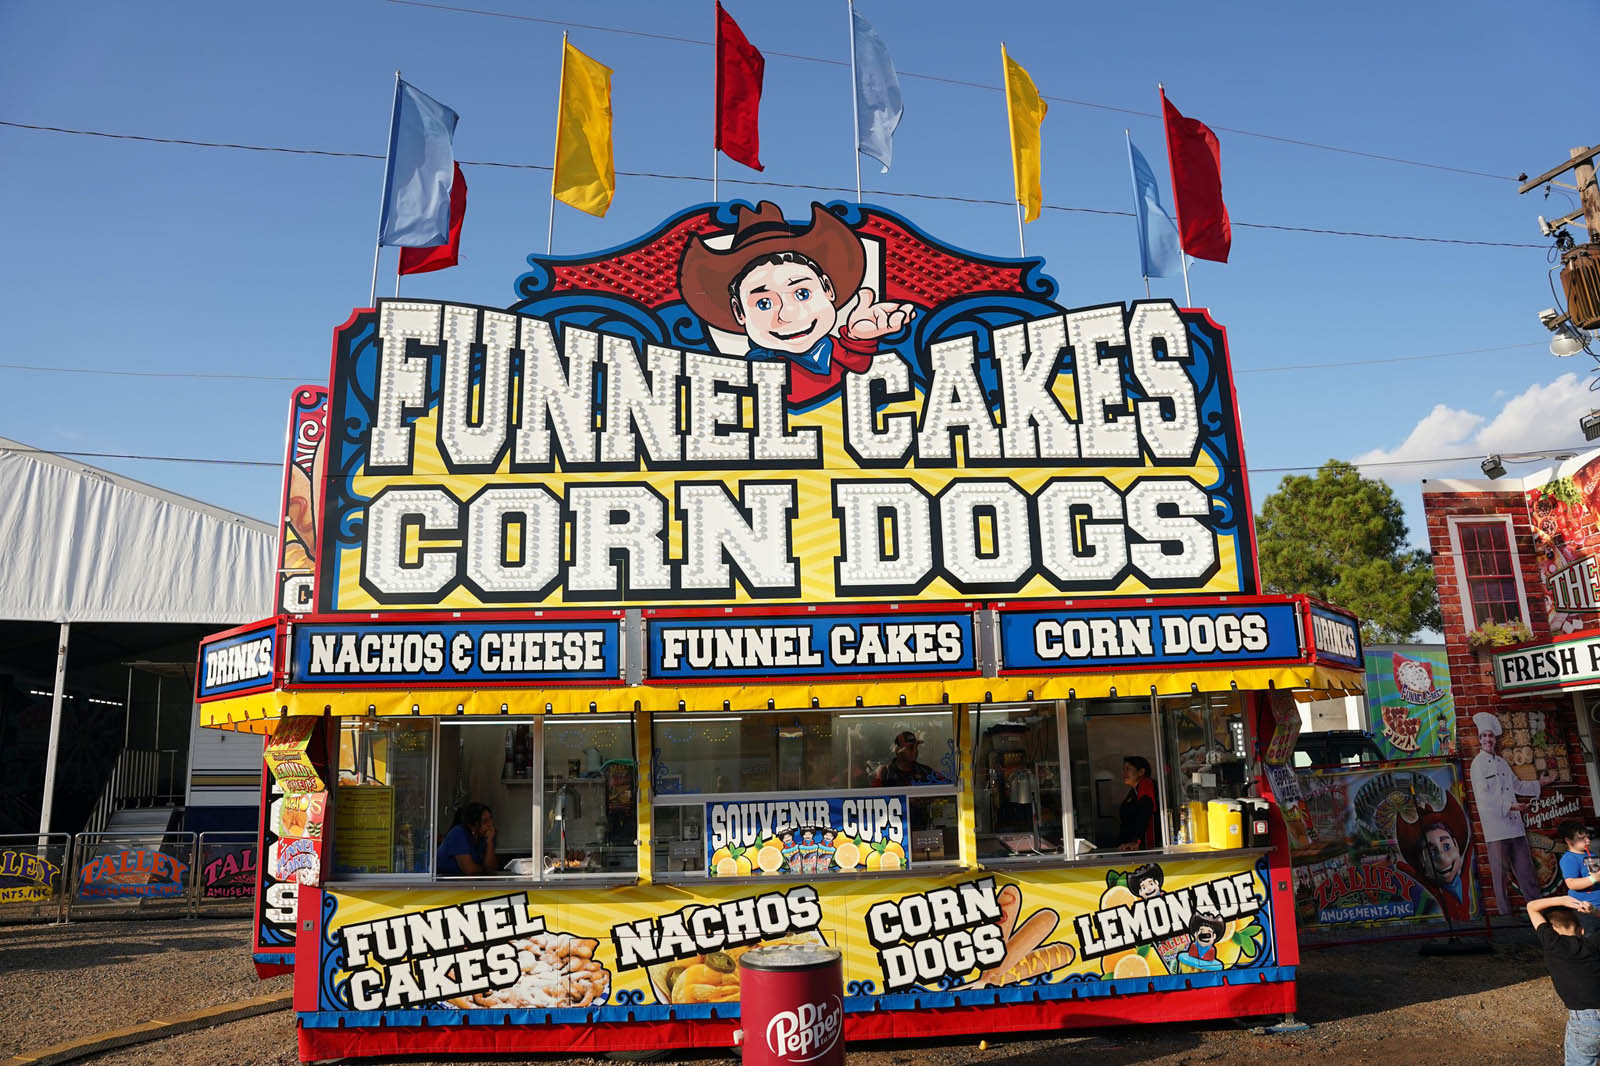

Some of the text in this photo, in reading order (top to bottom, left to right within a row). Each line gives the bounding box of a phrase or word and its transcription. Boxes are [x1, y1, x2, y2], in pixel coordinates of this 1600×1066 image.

[369, 300, 1200, 466] FUNNEL CAKES
[365, 480, 1216, 594] CORN DOGS
[1550, 557, 1600, 609] THE
[311, 631, 603, 673] NACHOS & CHEESE
[663, 623, 962, 668] FUNNEL CAKES
[1035, 614, 1267, 659] CORN DOGS
[1312, 614, 1356, 659] DRINKS
[205, 637, 273, 688] DRINKS
[1501, 647, 1579, 684] FRESH
[711, 798, 903, 850] SOUVENIR CUPS
[1523, 798, 1580, 828] Ingredients!
[1528, 790, 1565, 813] Fresh
[0, 850, 61, 888] LEY
[80, 848, 188, 886] TALLEY
[1313, 864, 1416, 911] TALLEY
[343, 892, 545, 967] FUNNEL
[616, 889, 822, 966] NACHOS
[870, 878, 1000, 941] CORN
[1079, 872, 1260, 955] LEMONADE
[350, 944, 520, 1011] CAKES
[883, 924, 1006, 988] DOGS
[767, 1008, 840, 1057] Pepper
[797, 1001, 827, 1031] Dr
